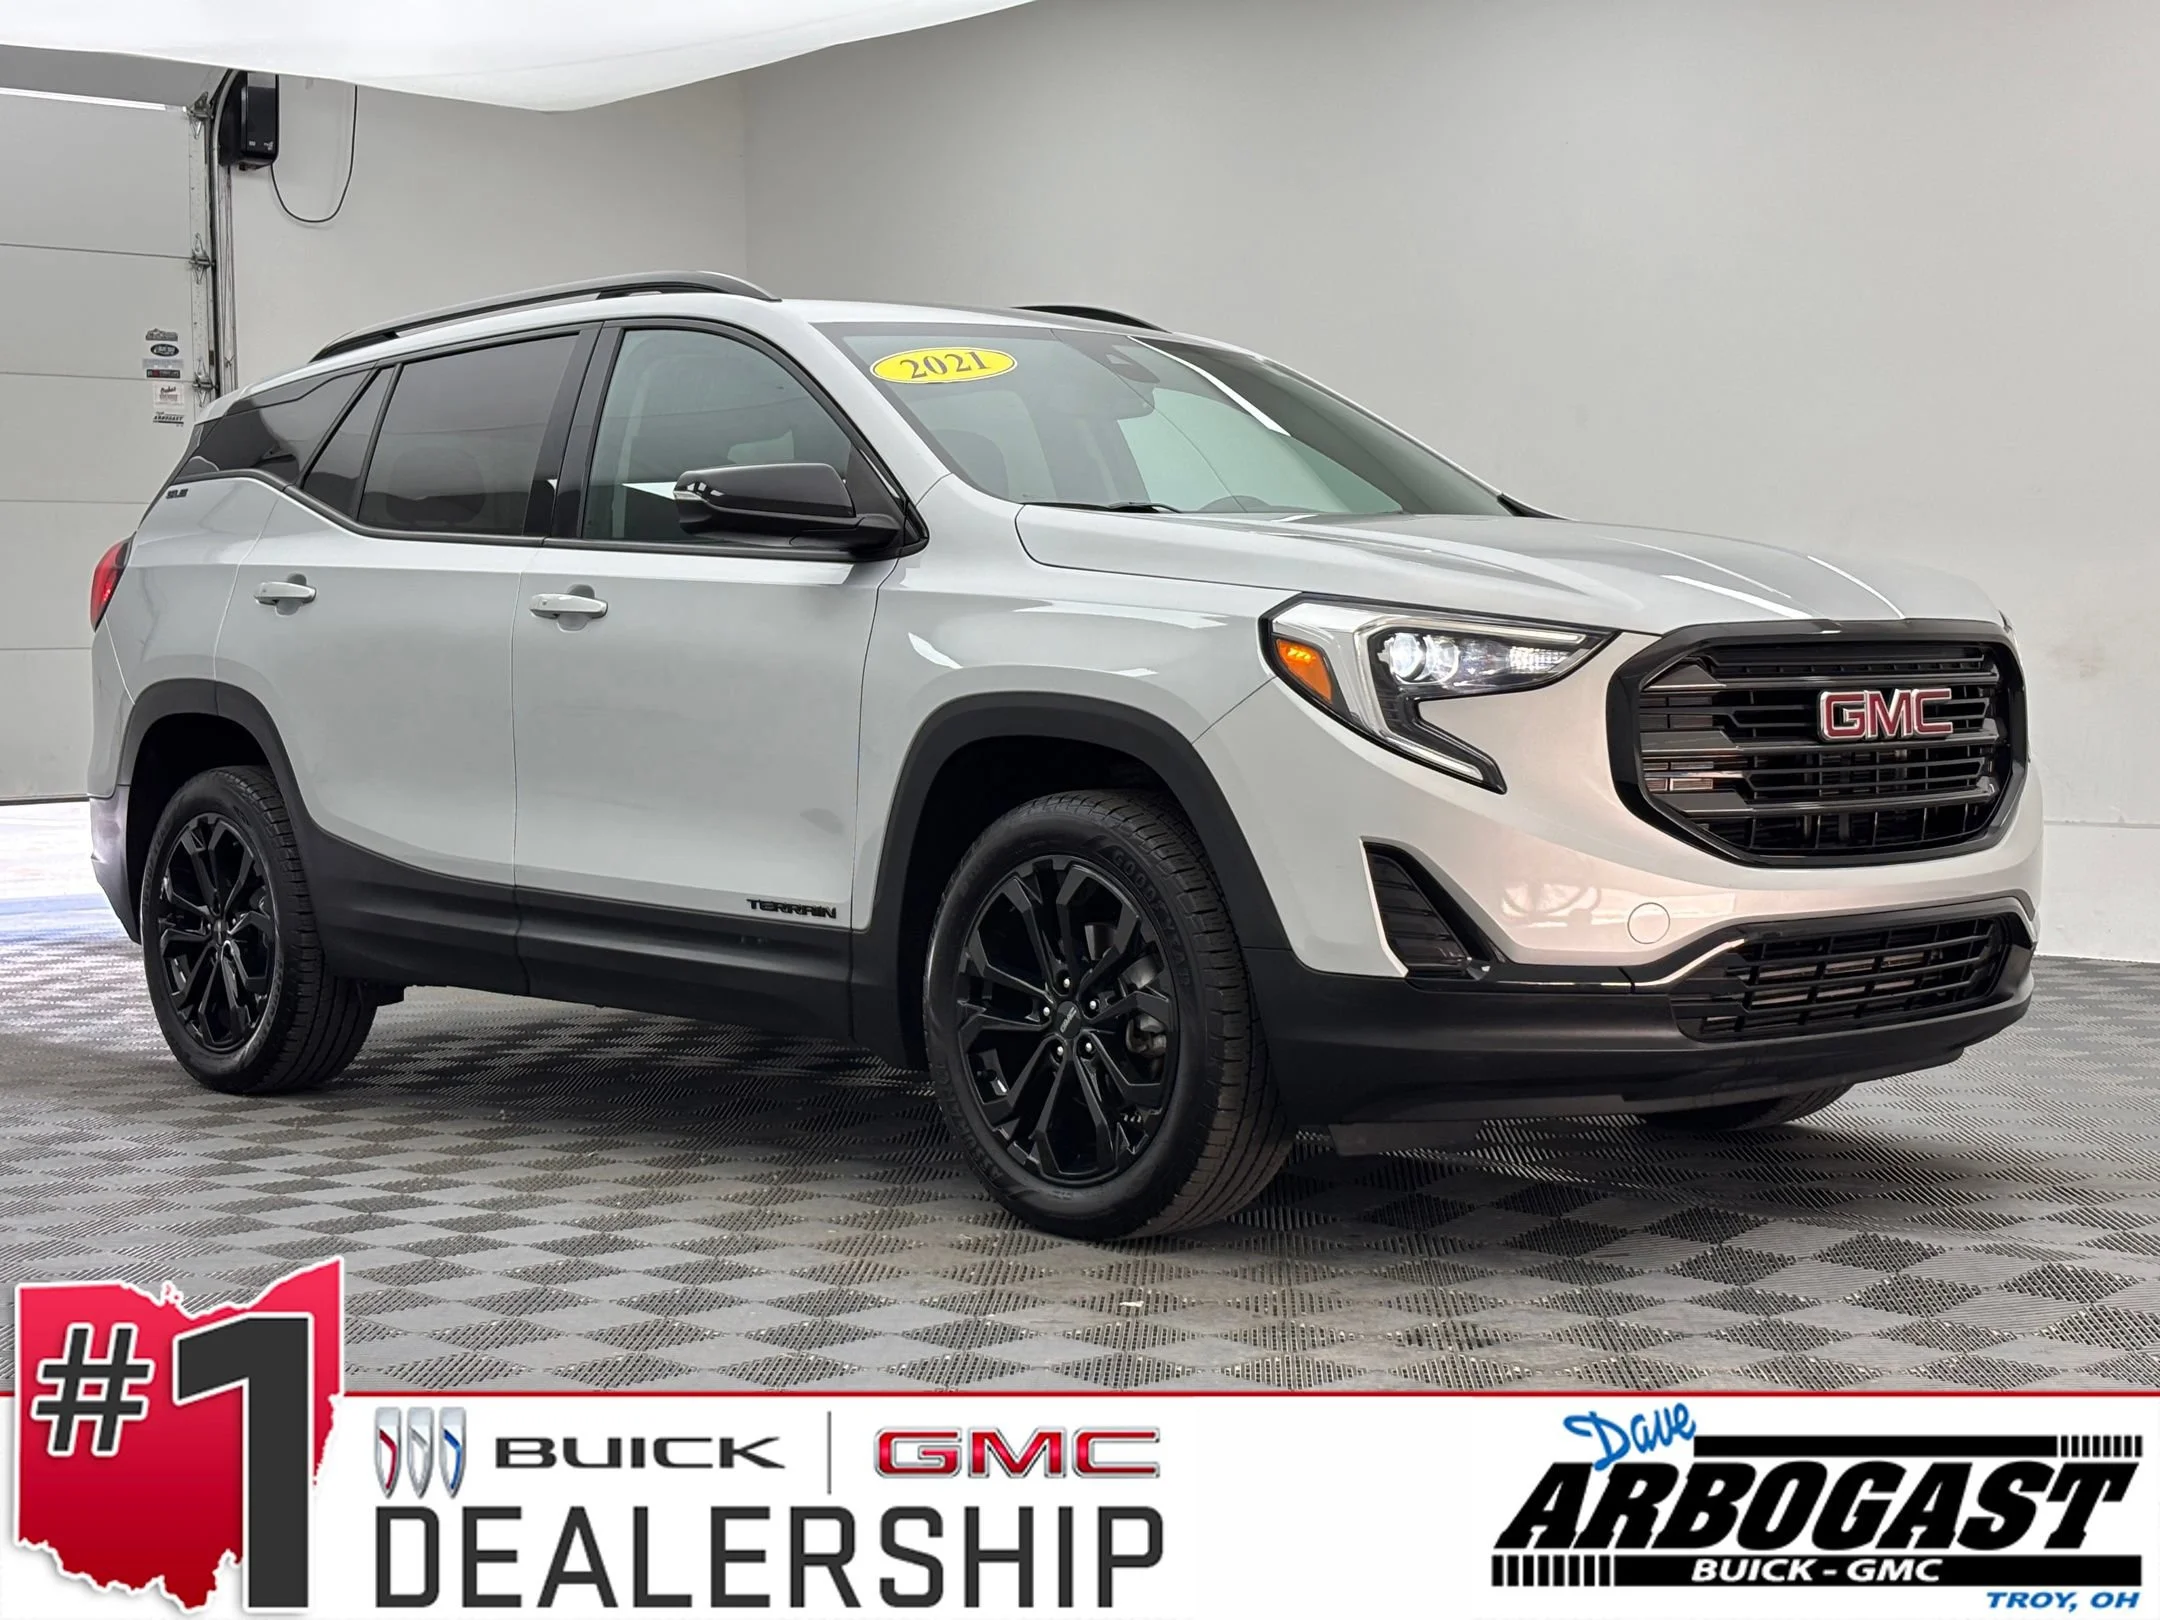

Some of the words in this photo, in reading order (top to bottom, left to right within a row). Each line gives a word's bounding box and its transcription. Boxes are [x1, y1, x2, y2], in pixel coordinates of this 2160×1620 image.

[899, 350, 992, 379] 2021
[1820, 688, 1953, 742] GMC
[746, 898, 837, 919] TERRAIN
